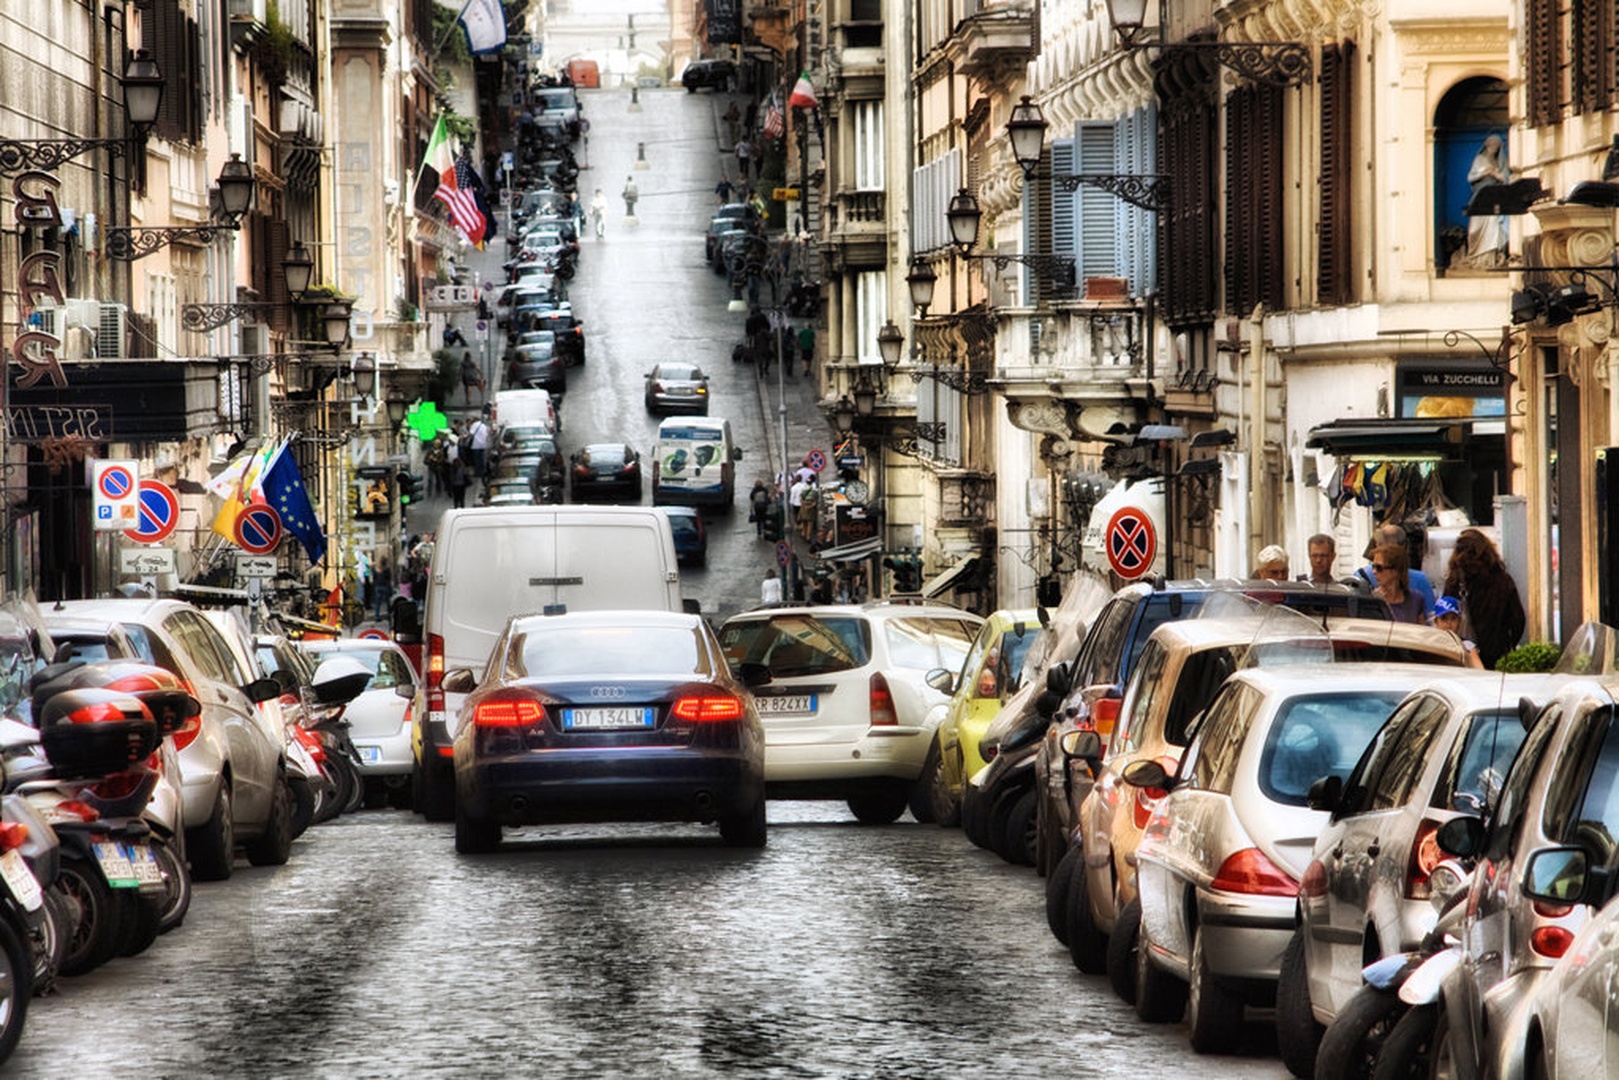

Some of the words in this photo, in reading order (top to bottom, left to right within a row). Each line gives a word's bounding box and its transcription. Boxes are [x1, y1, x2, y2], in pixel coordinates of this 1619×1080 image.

[1422, 374, 1439, 384] VIA
[1443, 374, 1499, 385] ZUCCHELLI
[772, 697, 809, 711] 824XX
[574, 710, 592, 725] DY
